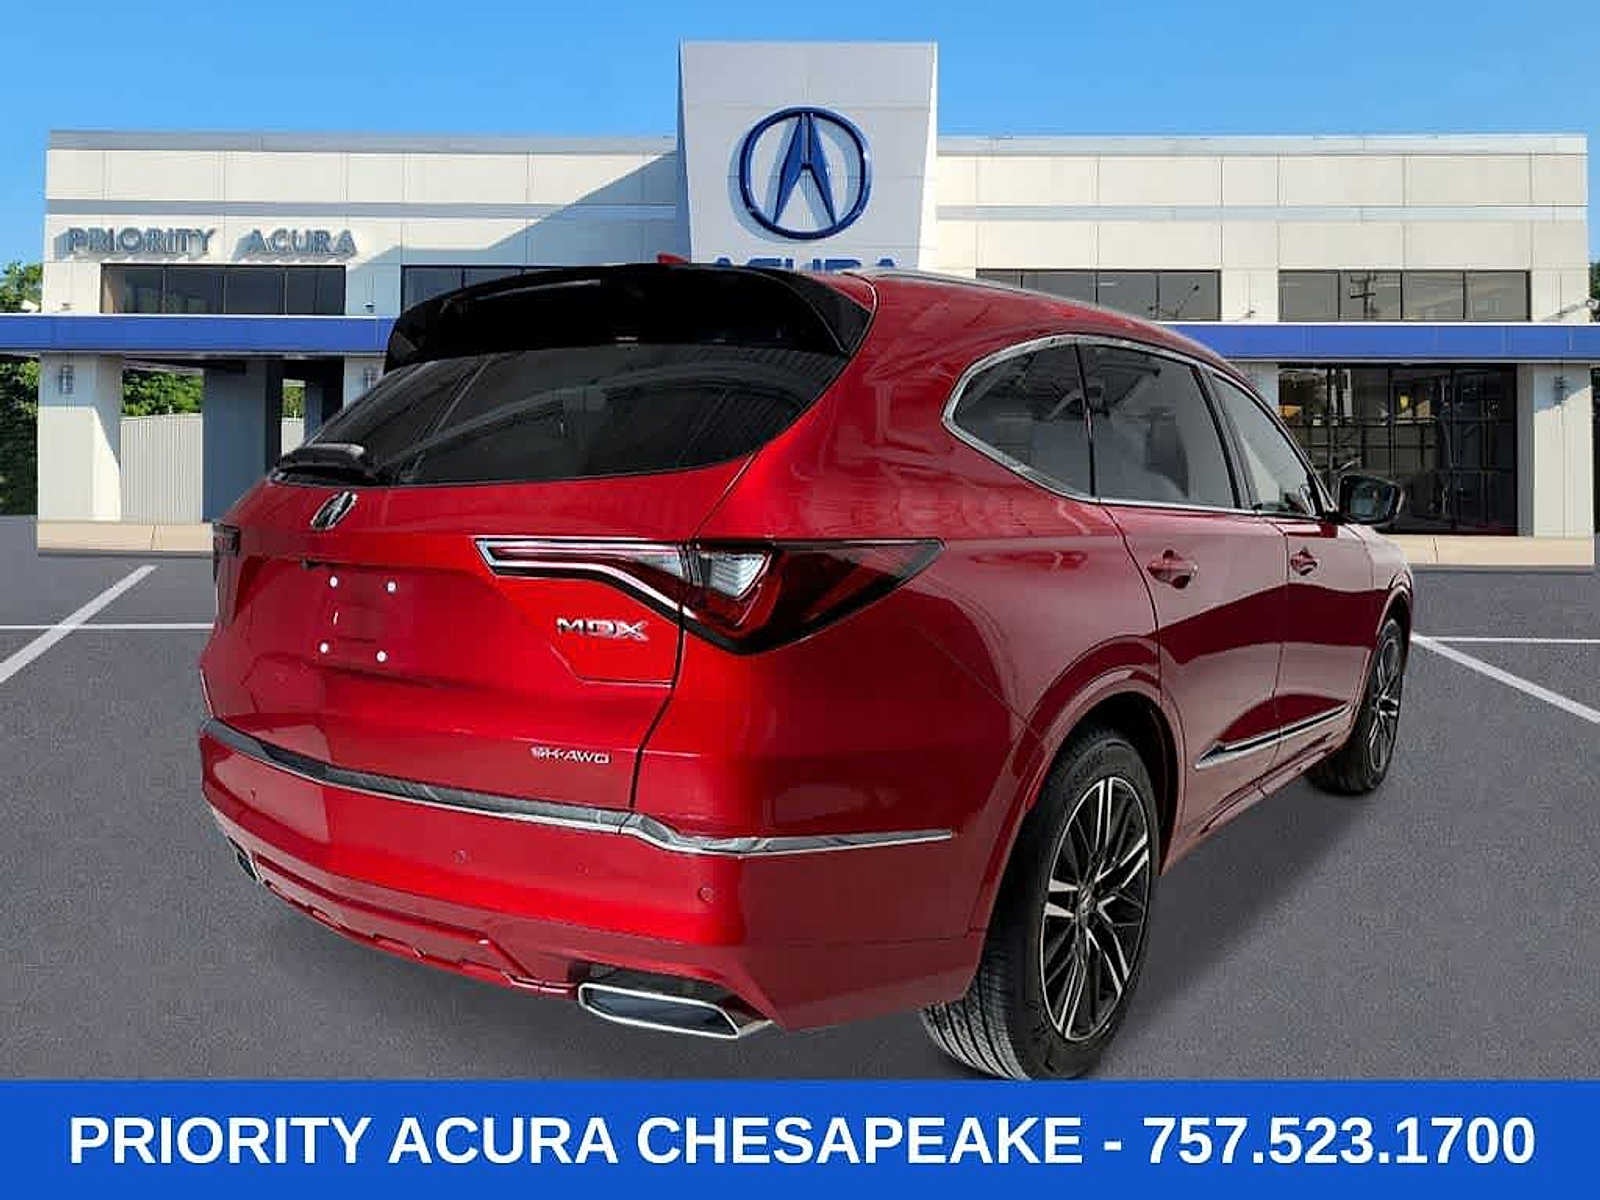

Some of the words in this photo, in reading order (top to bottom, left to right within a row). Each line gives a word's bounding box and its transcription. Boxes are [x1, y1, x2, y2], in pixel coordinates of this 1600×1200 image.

[68, 227, 215, 253] PRIORITY
[247, 228, 357, 257] ACURA
[556, 617, 649, 641] MDX
